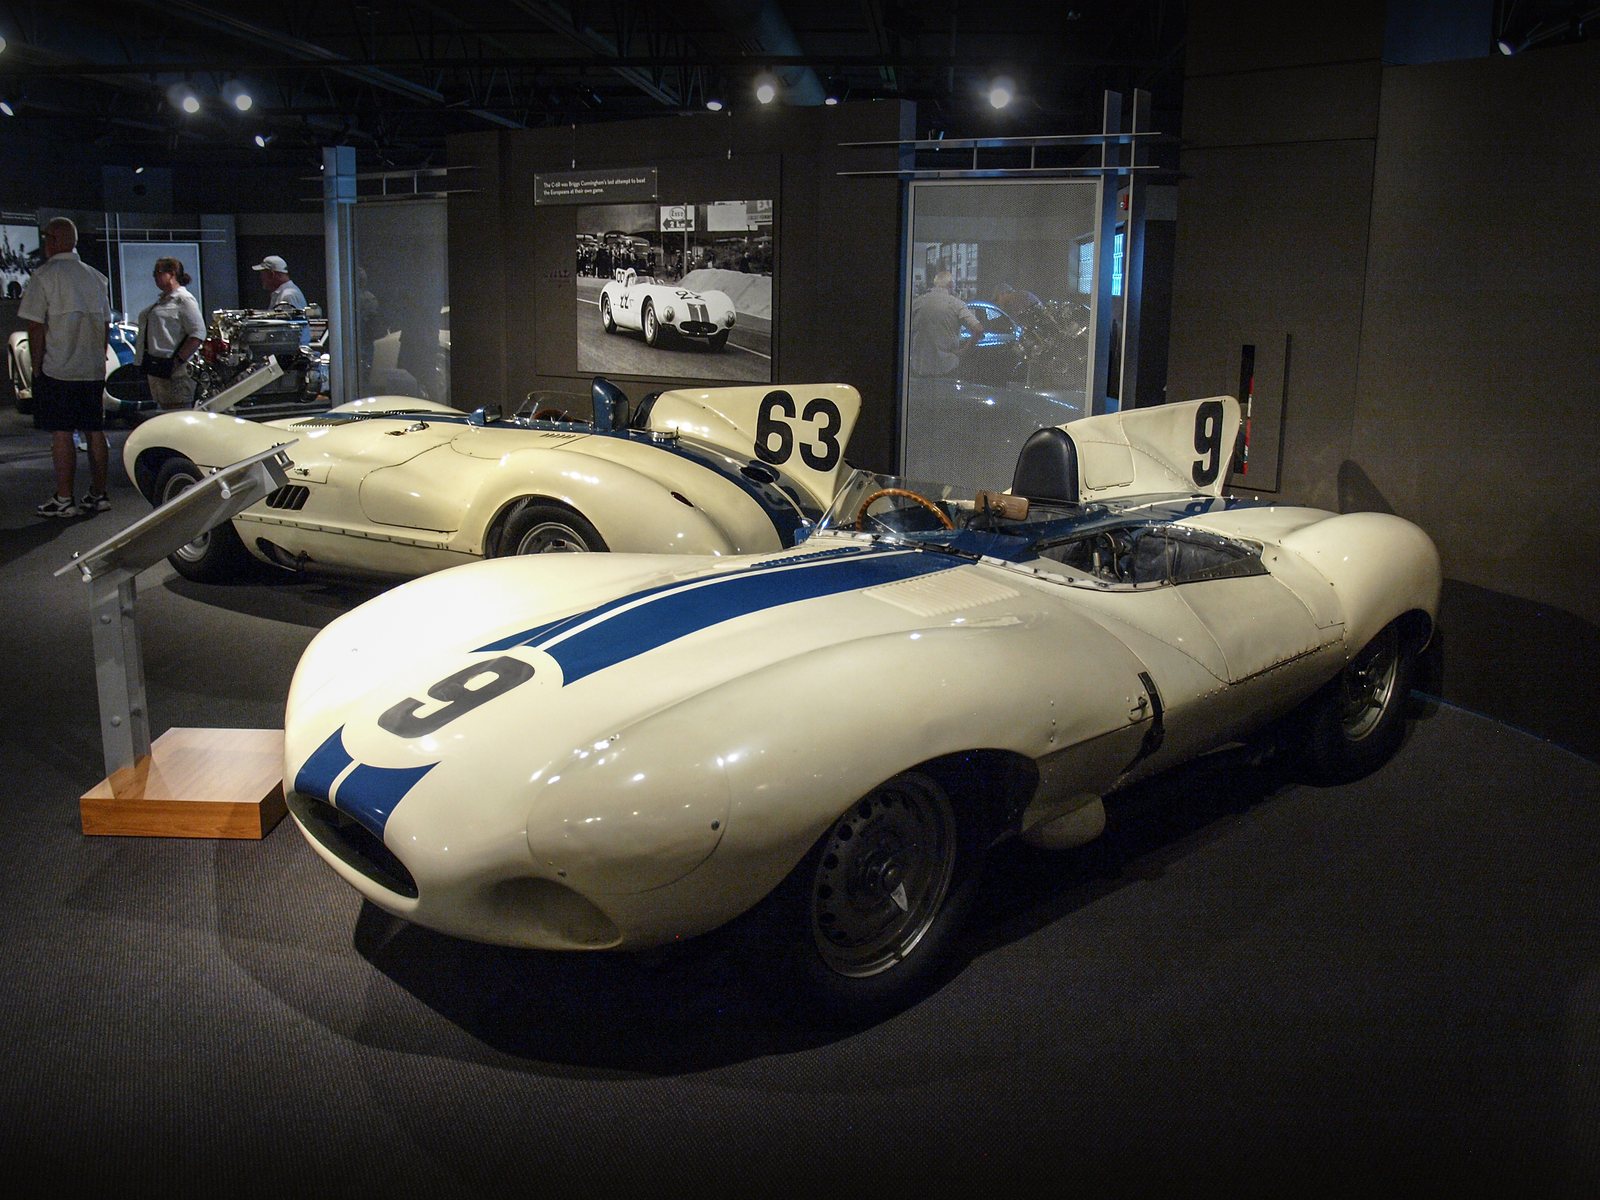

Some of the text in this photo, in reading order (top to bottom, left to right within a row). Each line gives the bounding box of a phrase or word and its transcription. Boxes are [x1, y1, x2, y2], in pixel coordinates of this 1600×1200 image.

[568, 180, 580, 188] Briggs
[581, 179, 607, 187] Cunningham's
[754, 390, 841, 472] 63
[1192, 401, 1224, 487] 9
[377, 656, 535, 738] 9
